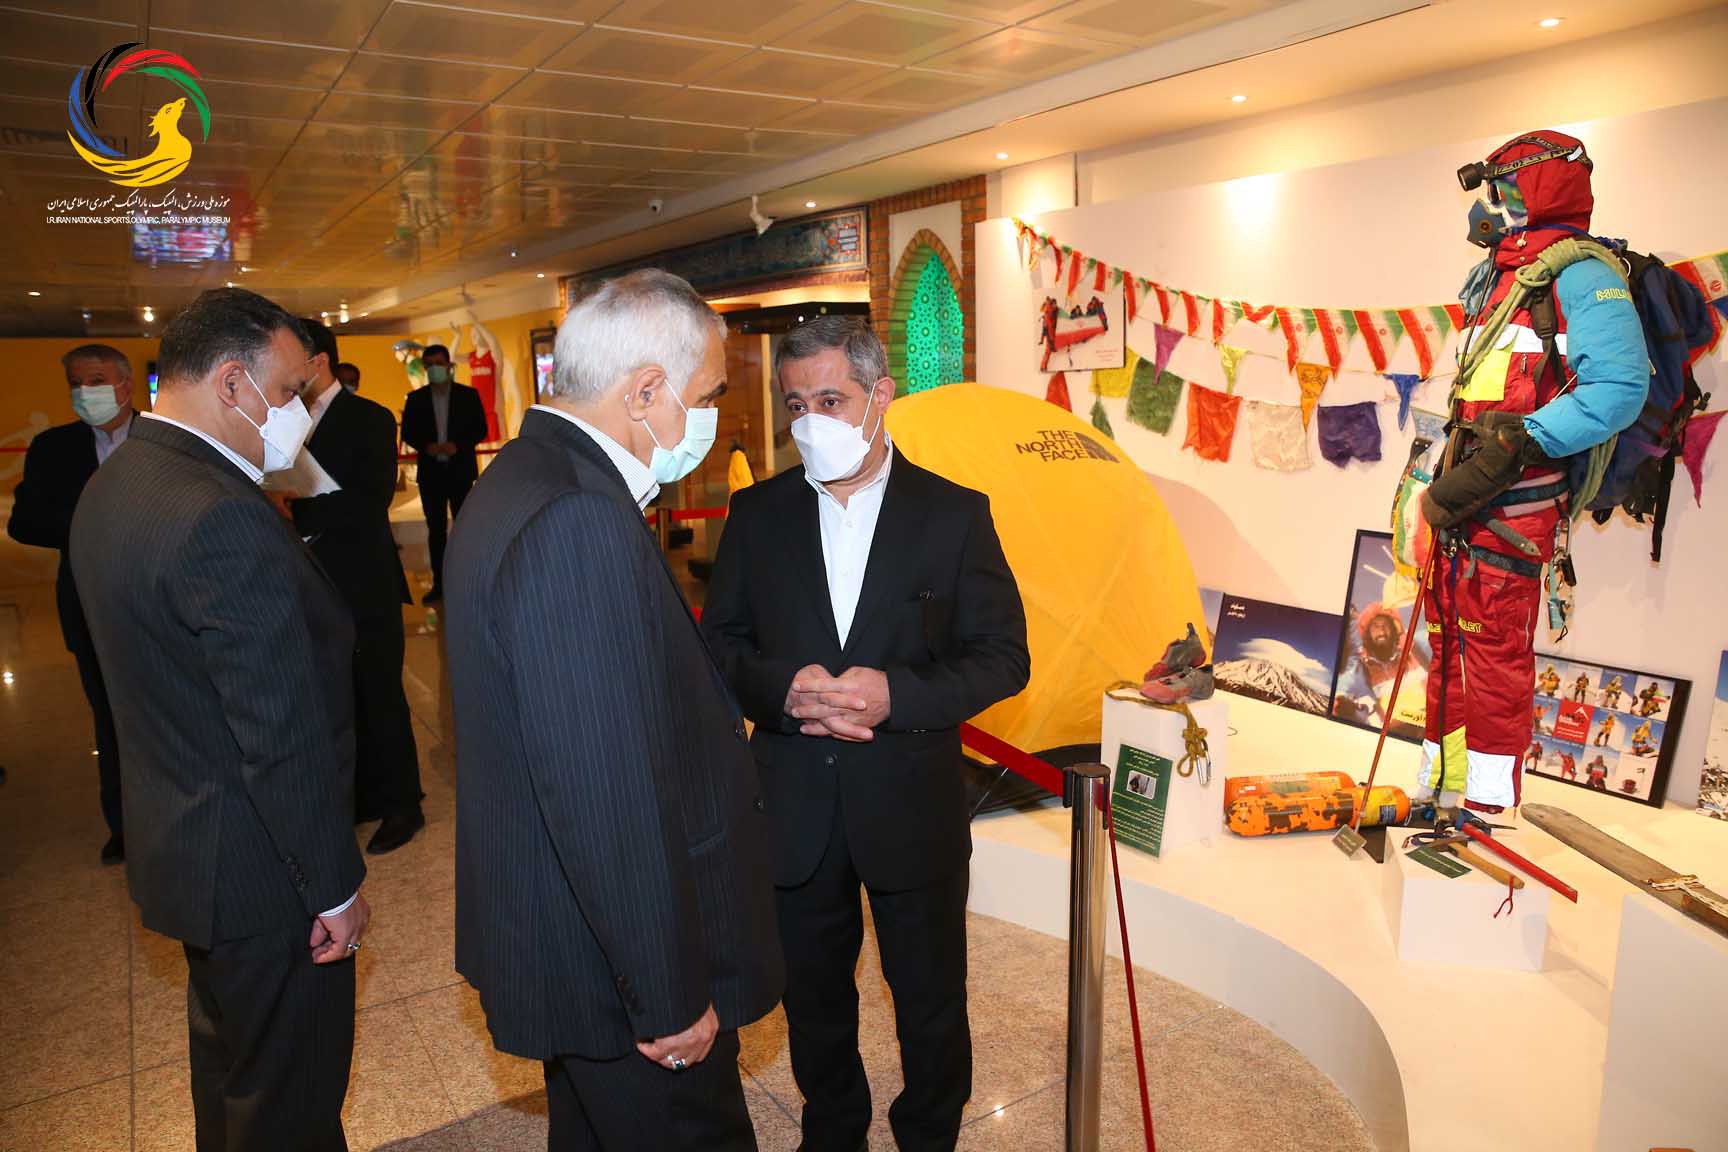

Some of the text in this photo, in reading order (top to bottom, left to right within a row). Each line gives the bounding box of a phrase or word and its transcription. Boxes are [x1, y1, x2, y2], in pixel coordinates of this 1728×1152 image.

[1037, 430, 1077, 441] THE
[1016, 439, 1082, 454] NORTH
[1040, 449, 1089, 462] FACE
